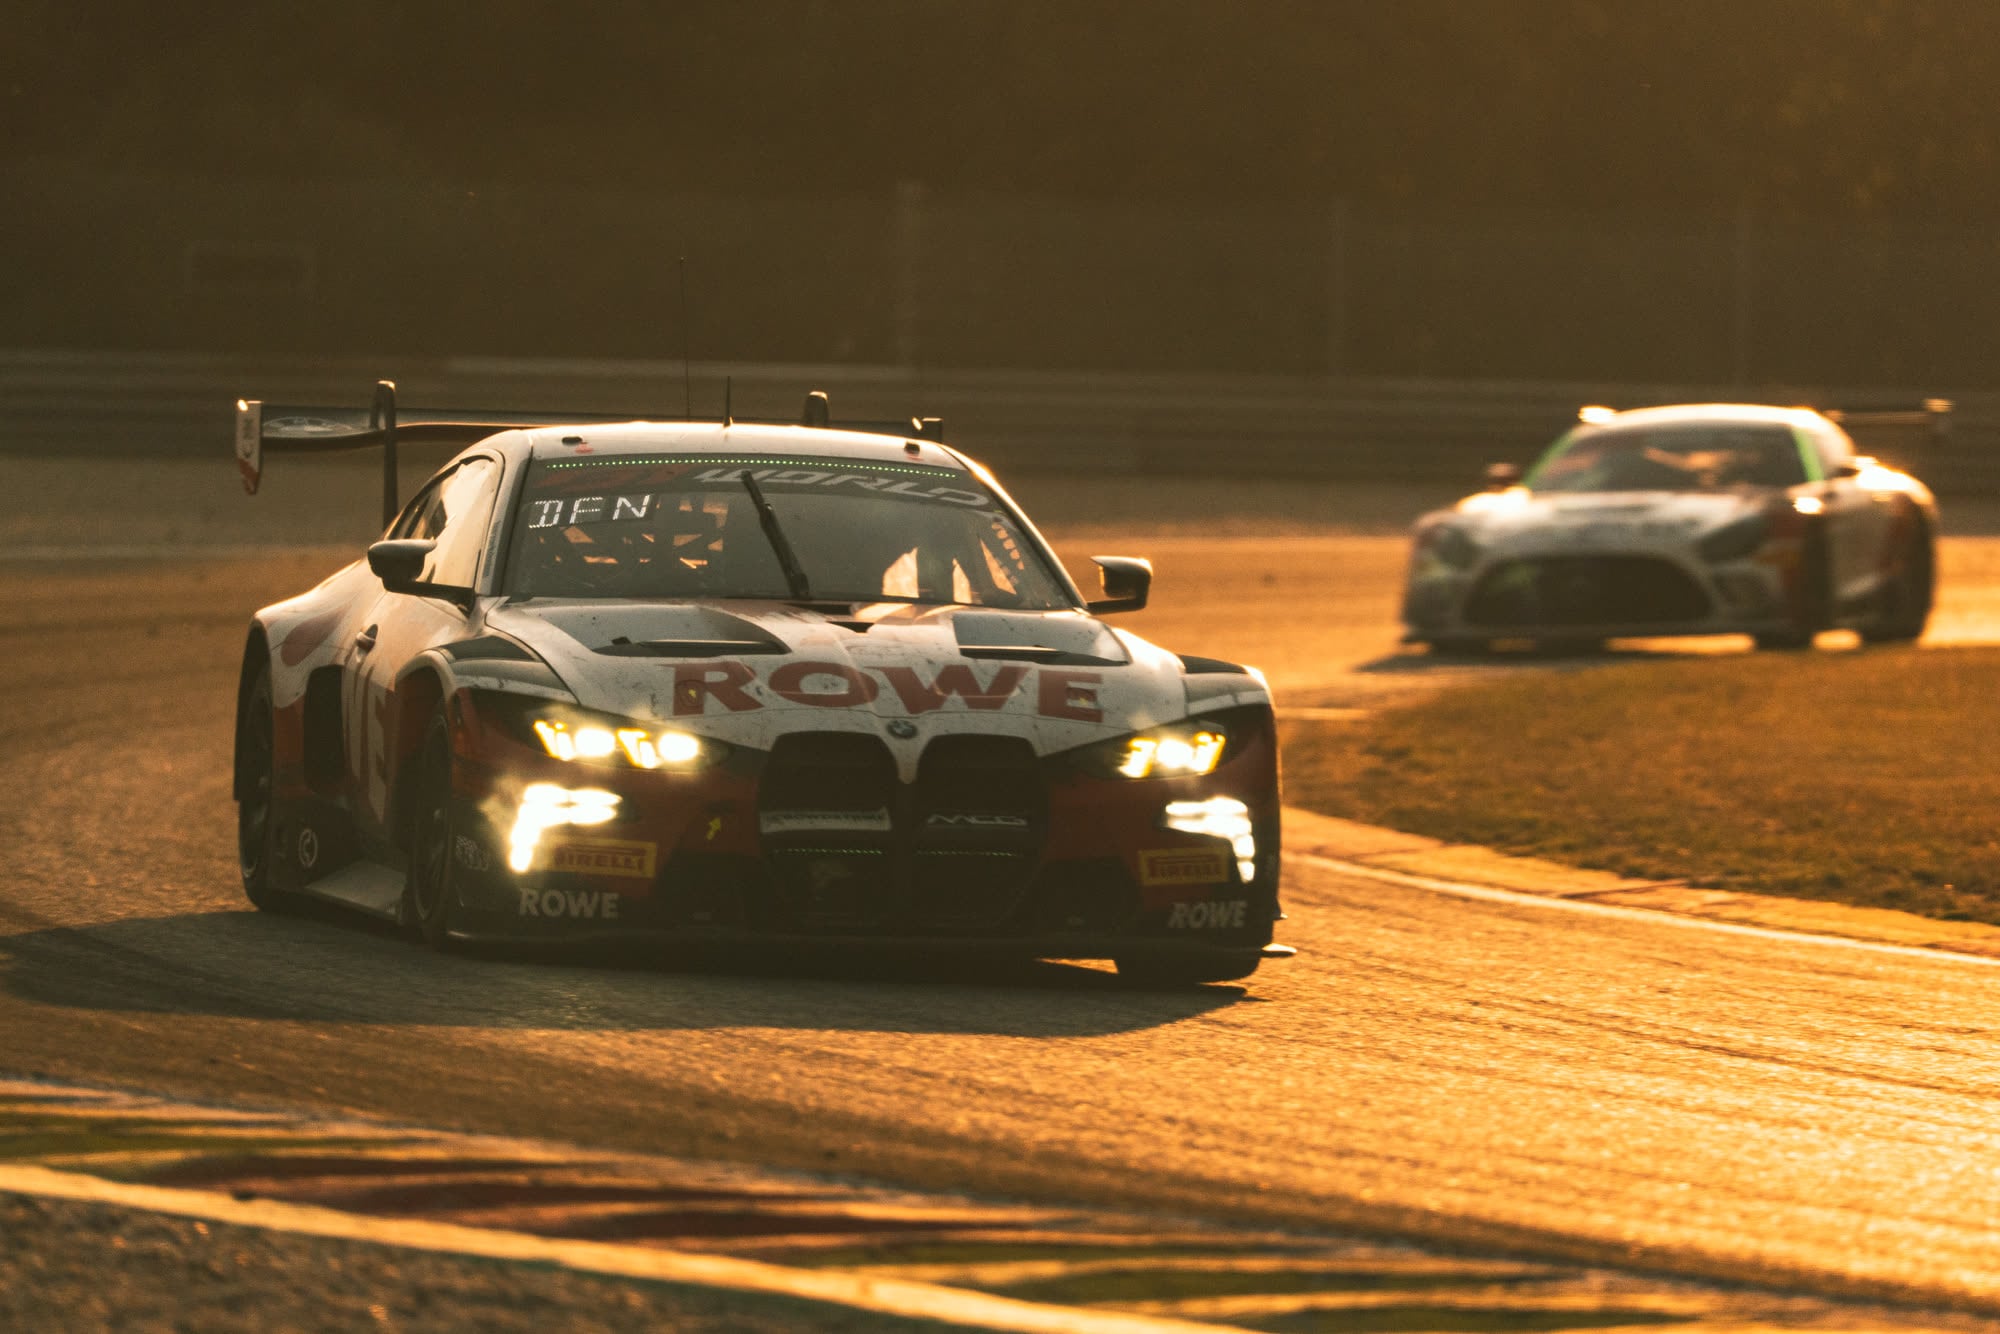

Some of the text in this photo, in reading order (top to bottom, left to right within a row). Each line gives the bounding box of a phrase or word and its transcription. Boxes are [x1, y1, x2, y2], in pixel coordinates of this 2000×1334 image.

[692, 468, 989, 507] WORLD
[658, 660, 1104, 723] ROWE
[554, 844, 646, 871] PIRELLI
[519, 887, 620, 919] ROWE
[1168, 900, 1248, 928] ROWE
